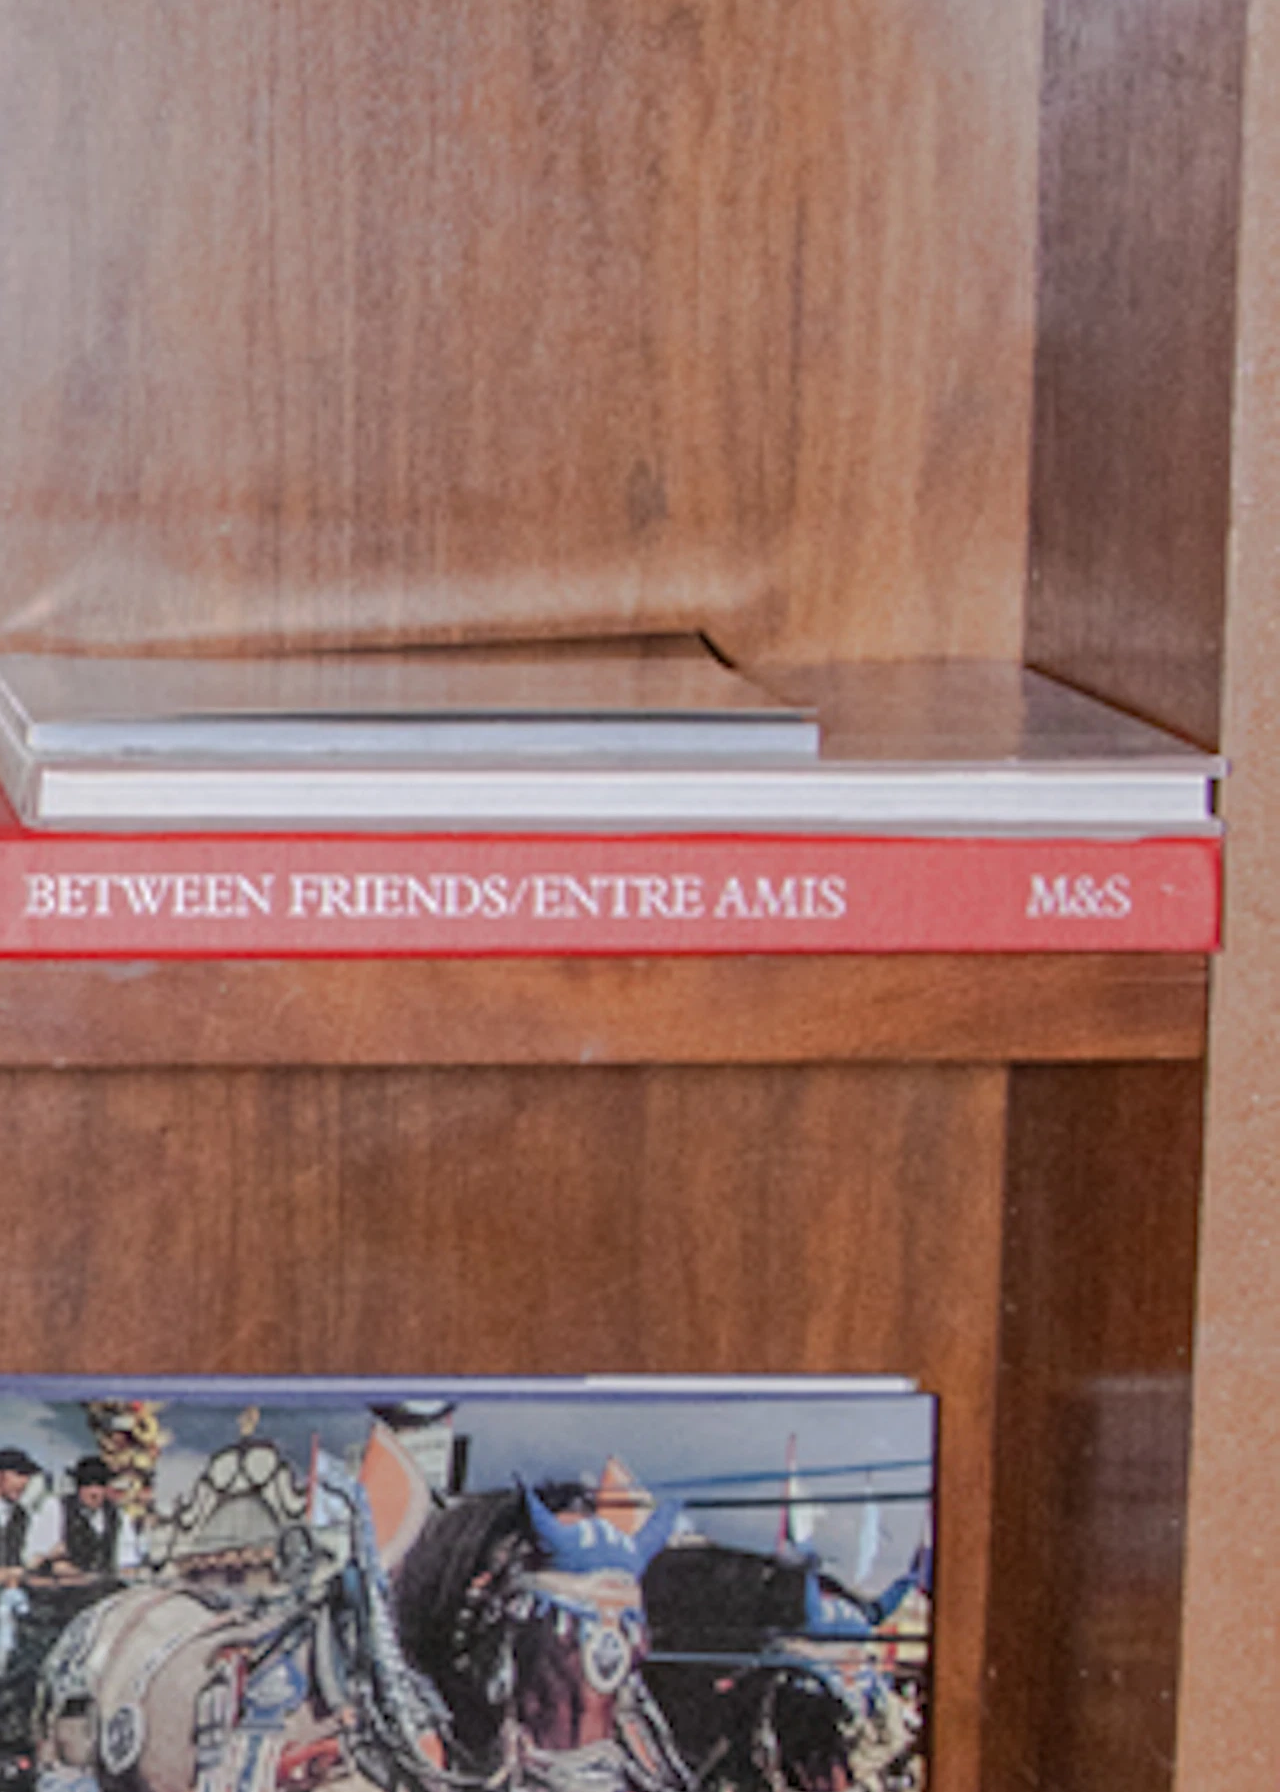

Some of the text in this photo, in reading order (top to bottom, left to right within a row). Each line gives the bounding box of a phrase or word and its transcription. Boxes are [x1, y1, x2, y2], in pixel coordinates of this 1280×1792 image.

[23, 873, 1132, 920] BETWEEN FRIENDS/ENTRE AMIS M&S
